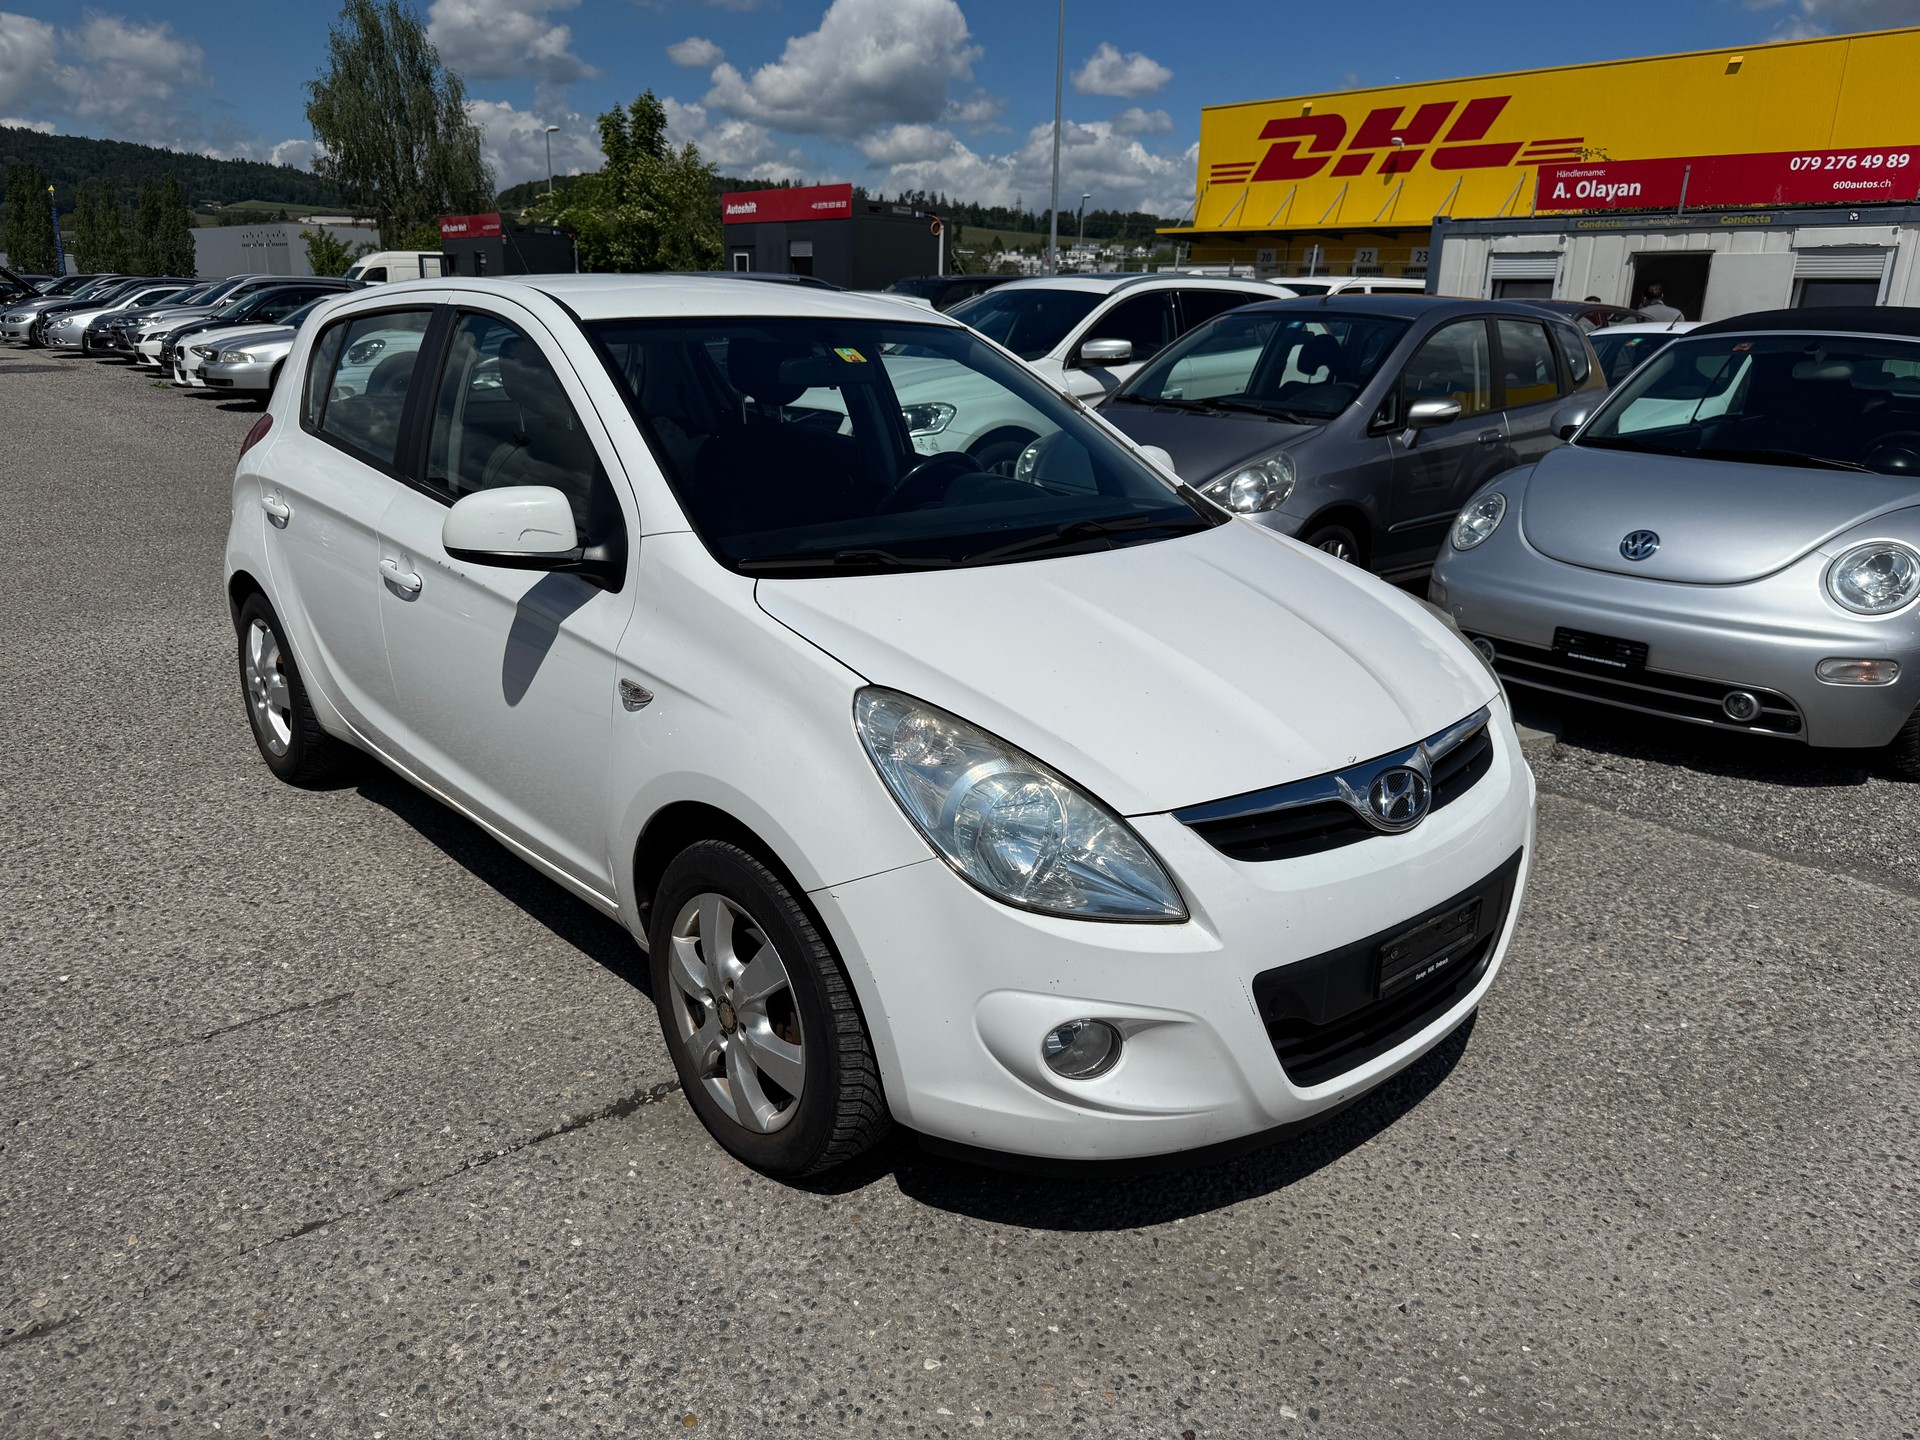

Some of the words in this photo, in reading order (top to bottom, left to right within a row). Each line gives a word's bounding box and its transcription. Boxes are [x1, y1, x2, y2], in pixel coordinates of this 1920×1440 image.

[1250, 95, 1525, 182] DHL
[1790, 157, 1821, 171] 079
[1824, 155, 1857, 170] 276
[1860, 154, 1883, 169] 49
[1886, 153, 1910, 168] 89
[1556, 169, 1605, 178] Händlername:
[1832, 179, 1891, 189] 600autos.ch
[1552, 181, 1571, 198] A.
[1575, 179, 1641, 201] Olayan
[726, 202, 757, 215] Autoshift
[1577, 219, 1622, 228] Condecta
[1720, 215, 1772, 225] Condecta
[1261, 253, 1272, 262] 20
[1360, 252, 1372, 262] 22
[1416, 252, 1428, 262] 23
